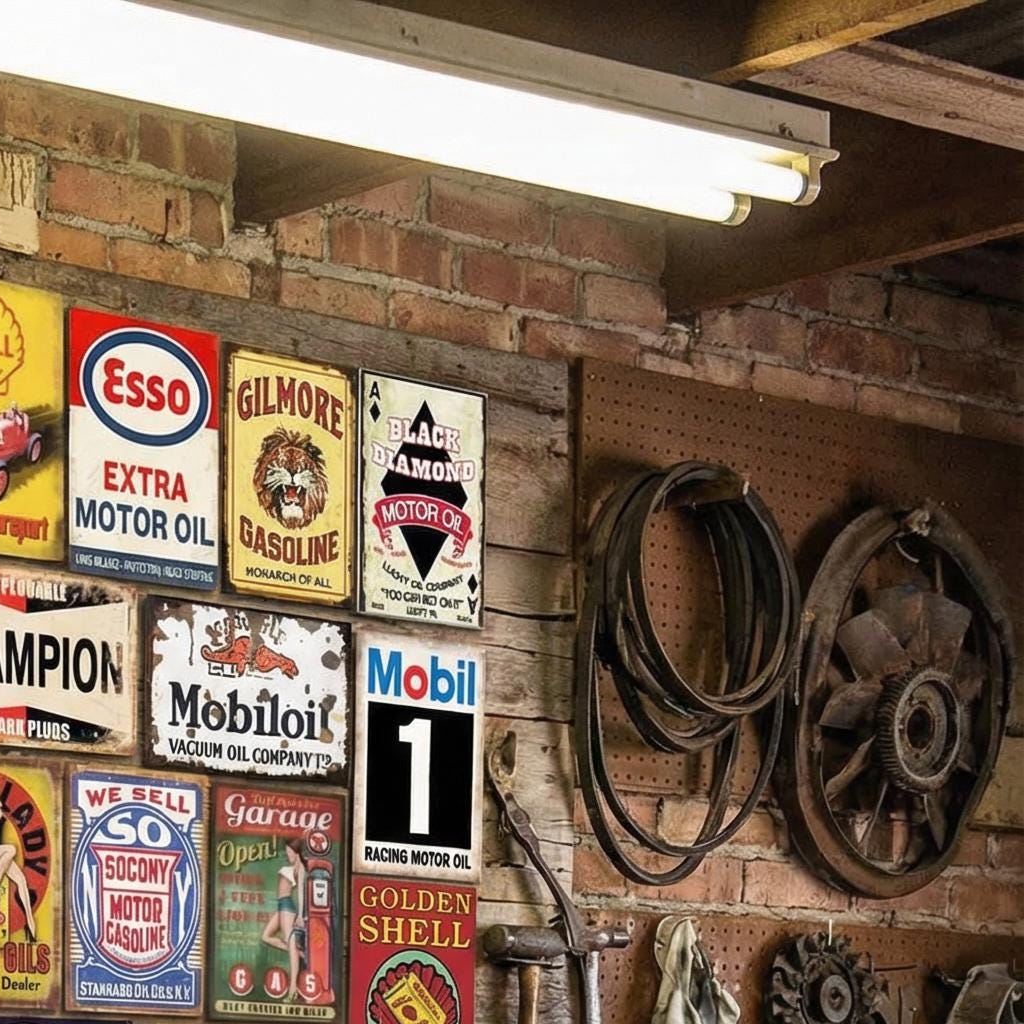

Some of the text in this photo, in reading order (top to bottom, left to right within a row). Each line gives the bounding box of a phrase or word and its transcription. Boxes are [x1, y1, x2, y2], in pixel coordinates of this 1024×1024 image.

[237, 375, 344, 440] GILMORE
[387, 417, 461, 453] BLACK
[371, 442, 476, 482] DIAMOND
[103, 461, 188, 503] EXTRA
[76, 497, 214, 547] MOTOR OIL
[382, 503, 437, 526] MOTOR
[240, 515, 339, 566] GASOLINE
[298, 574, 312, 587] OF
[313, 576, 332, 589] ALL
[367, 647, 476, 706] Mobil
[168, 681, 331, 742] Mobiloil
[169, 738, 223, 759] VACUUM
[227, 745, 250, 762] OIL
[252, 747, 312, 767] COMPANY
[398, 718, 431, 835] 1
[86, 787, 190, 814] WE SELL
[224, 793, 333, 831] Garage
[105, 855, 169, 885] SOCONY
[364, 846, 472, 870] RACING MOTOR OIL
[109, 894, 161, 922] MOTOR
[359, 885, 472, 914] GOLDEN
[106, 922, 166, 953] GASOLINE
[359, 915, 471, 948] SHELL
[2, 976, 41, 992] Dealer
